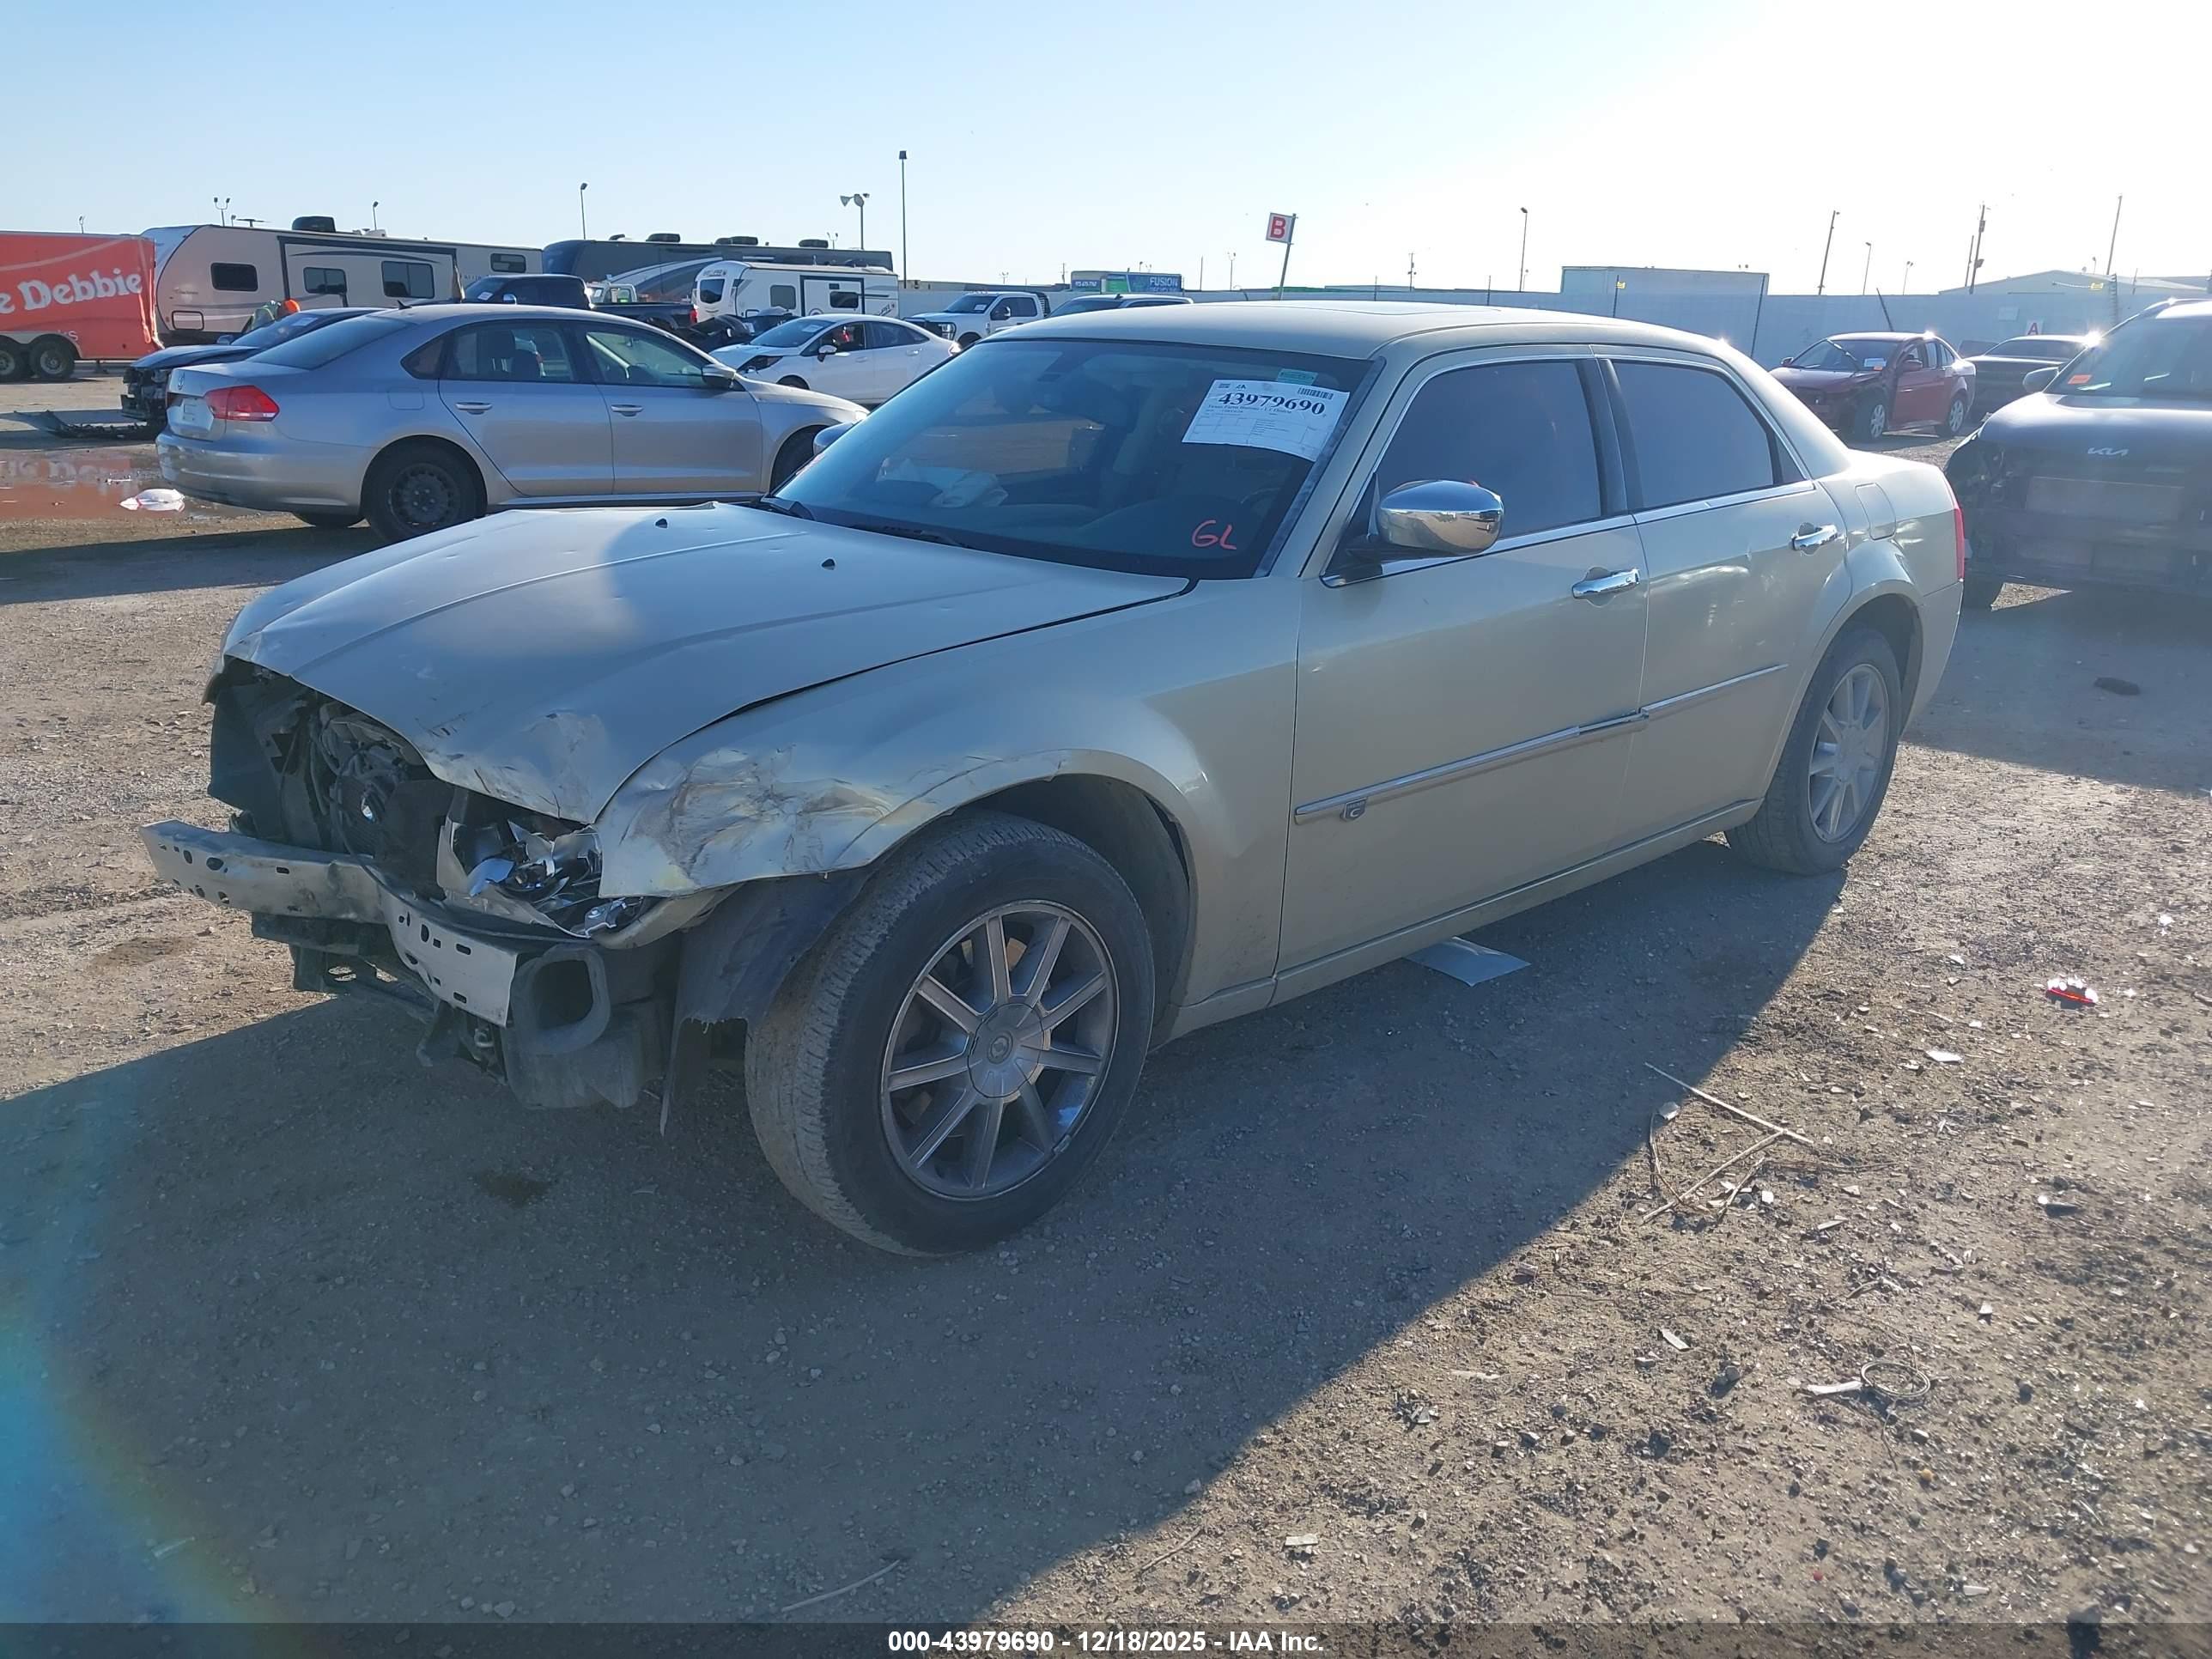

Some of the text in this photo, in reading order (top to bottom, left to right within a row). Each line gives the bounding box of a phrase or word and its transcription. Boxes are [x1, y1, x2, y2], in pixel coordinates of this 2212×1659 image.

[1270, 216, 1286, 239] B
[17, 268, 143, 311] Debbie
[1149, 276, 1179, 287] FUSION
[2027, 322, 2039, 335] A
[1218, 392, 1326, 416] 43979690
